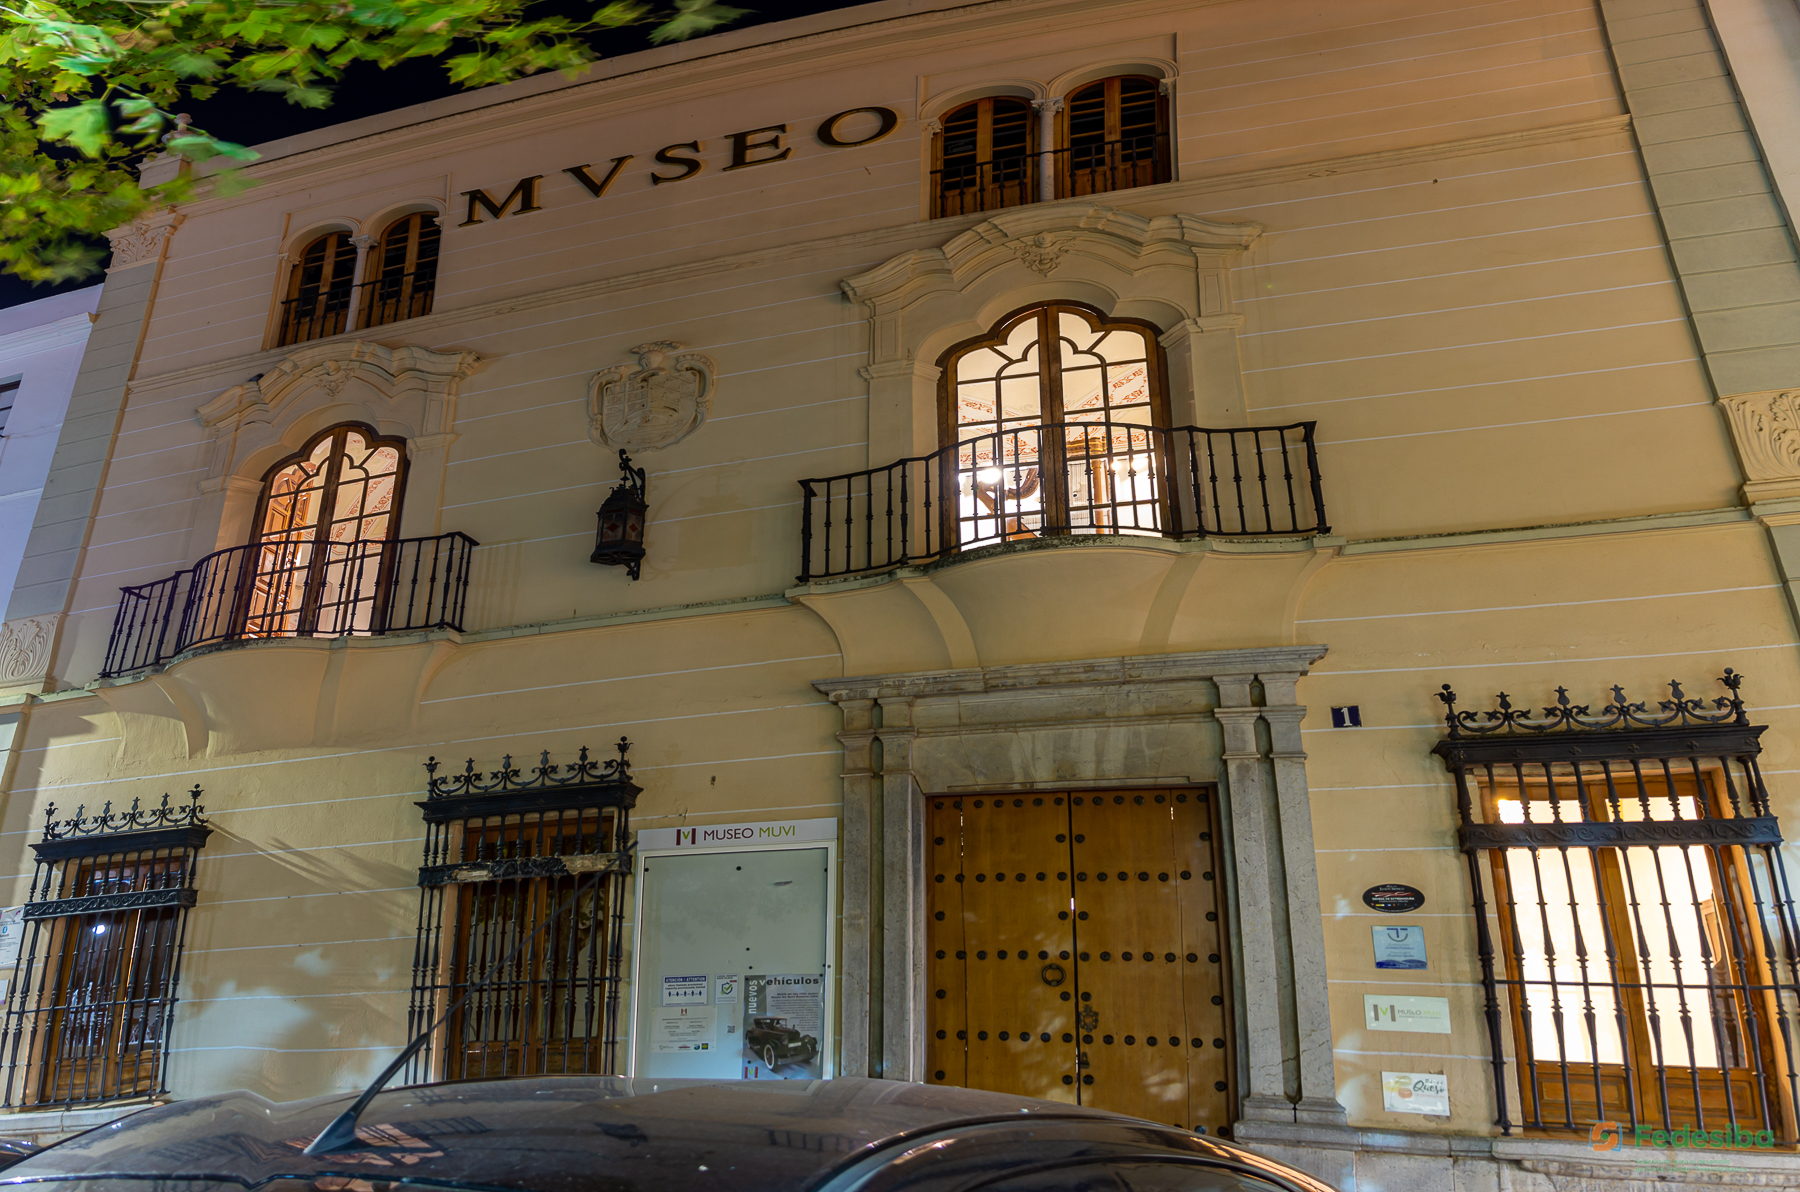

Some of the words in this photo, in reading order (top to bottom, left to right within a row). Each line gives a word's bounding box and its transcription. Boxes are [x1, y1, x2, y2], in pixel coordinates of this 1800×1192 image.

[457, 106, 899, 228] MVSEO
[1340, 707, 1353, 727] 1
[703, 827, 754, 841] MUSEO
[758, 825, 796, 838] MUVI
[758, 976, 819, 986] vehículos
[748, 979, 758, 1015] nuevos
